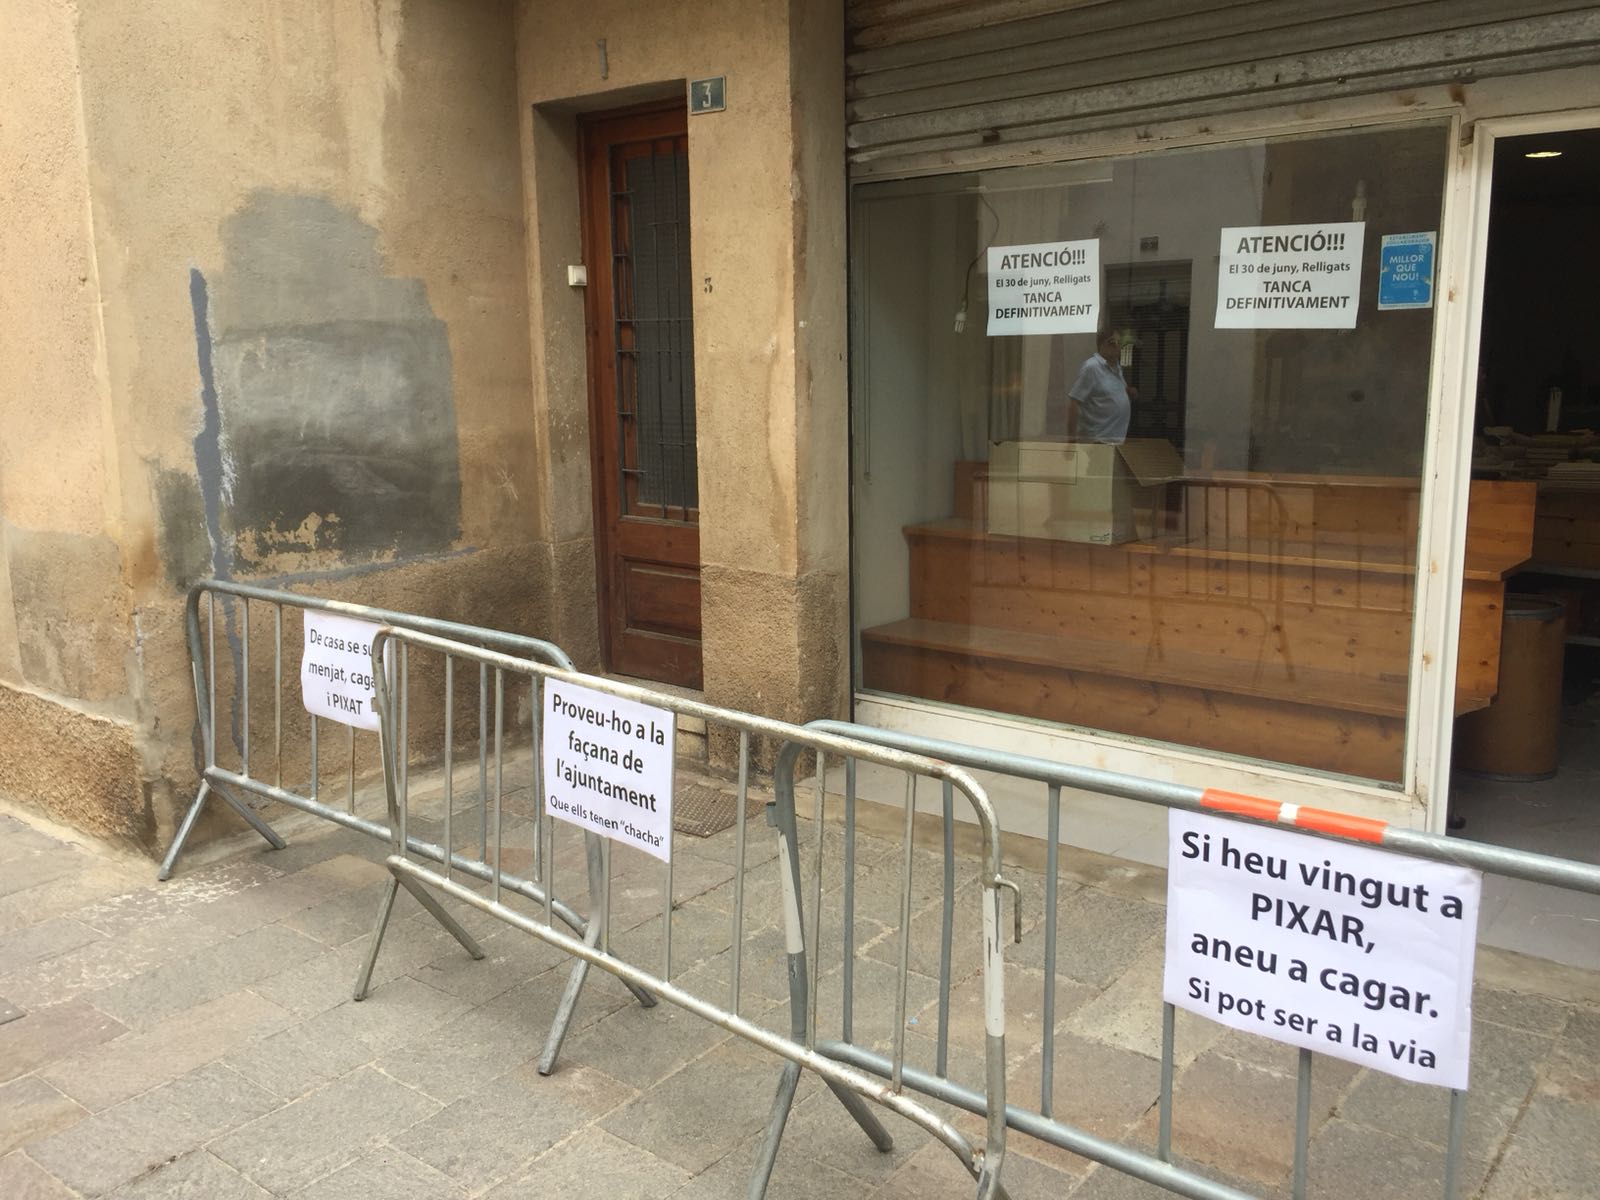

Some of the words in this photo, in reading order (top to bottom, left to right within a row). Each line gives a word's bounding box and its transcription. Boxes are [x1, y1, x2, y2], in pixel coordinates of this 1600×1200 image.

[702, 82, 712, 108] 3
[1237, 230, 1345, 254] ATENCIÓ!!!
[1001, 247, 1086, 270] ATENCIÓ!!!
[1229, 264, 1238, 274] El
[1242, 264, 1254, 274] 30
[1257, 263, 1270, 273] de
[1272, 263, 1299, 275] juny,
[1302, 262, 1350, 274] Relligats
[1389, 255, 1424, 264] MILLOR
[1396, 264, 1416, 273] QUE
[996, 279, 1004, 288] El
[1006, 279, 1016, 288] 30
[1017, 278, 1029, 287] de
[1029, 277, 1051, 288] juny,
[1053, 274, 1092, 286] Relligats
[1263, 280, 1312, 293] TANCA
[1392, 272, 1419, 281] NOU!
[1023, 291, 1062, 304] TANCA
[1226, 296, 1350, 309] DEFINITIVAMENT
[995, 304, 1092, 319] DEFINITIVAMENT
[310, 628, 322, 646] De
[324, 636, 345, 651] casa
[347, 641, 360, 654] se
[308, 662, 348, 684] menjat,
[350, 672, 376, 691] caga
[327, 691, 331, 706] i
[332, 693, 363, 715] PIXAT
[553, 694, 632, 735] Proveu-ho
[635, 724, 645, 740] a
[651, 721, 664, 745] la
[568, 730, 618, 766] façana
[622, 749, 643, 774] de
[556, 758, 656, 812] l'ajuntament
[550, 795, 570, 813] Que
[571, 803, 587, 819] ells
[589, 810, 618, 830] tenen
[1182, 831, 1210, 863] Si
[1221, 837, 1287, 880] heu
[1299, 860, 1429, 912] vingut
[1440, 895, 1463, 920] a
[1251, 893, 1375, 954] PIXAR,
[1190, 933, 1277, 974] aneu
[1288, 958, 1308, 983] a
[1319, 967, 1439, 1018] cagar.
[1188, 977, 1210, 1003] Si
[1218, 991, 1266, 1021] pot
[1273, 1008, 1318, 1035] ser
[1325, 1023, 1342, 1043] a
[1352, 1023, 1378, 1054] la
[1388, 1039, 1436, 1069] via
